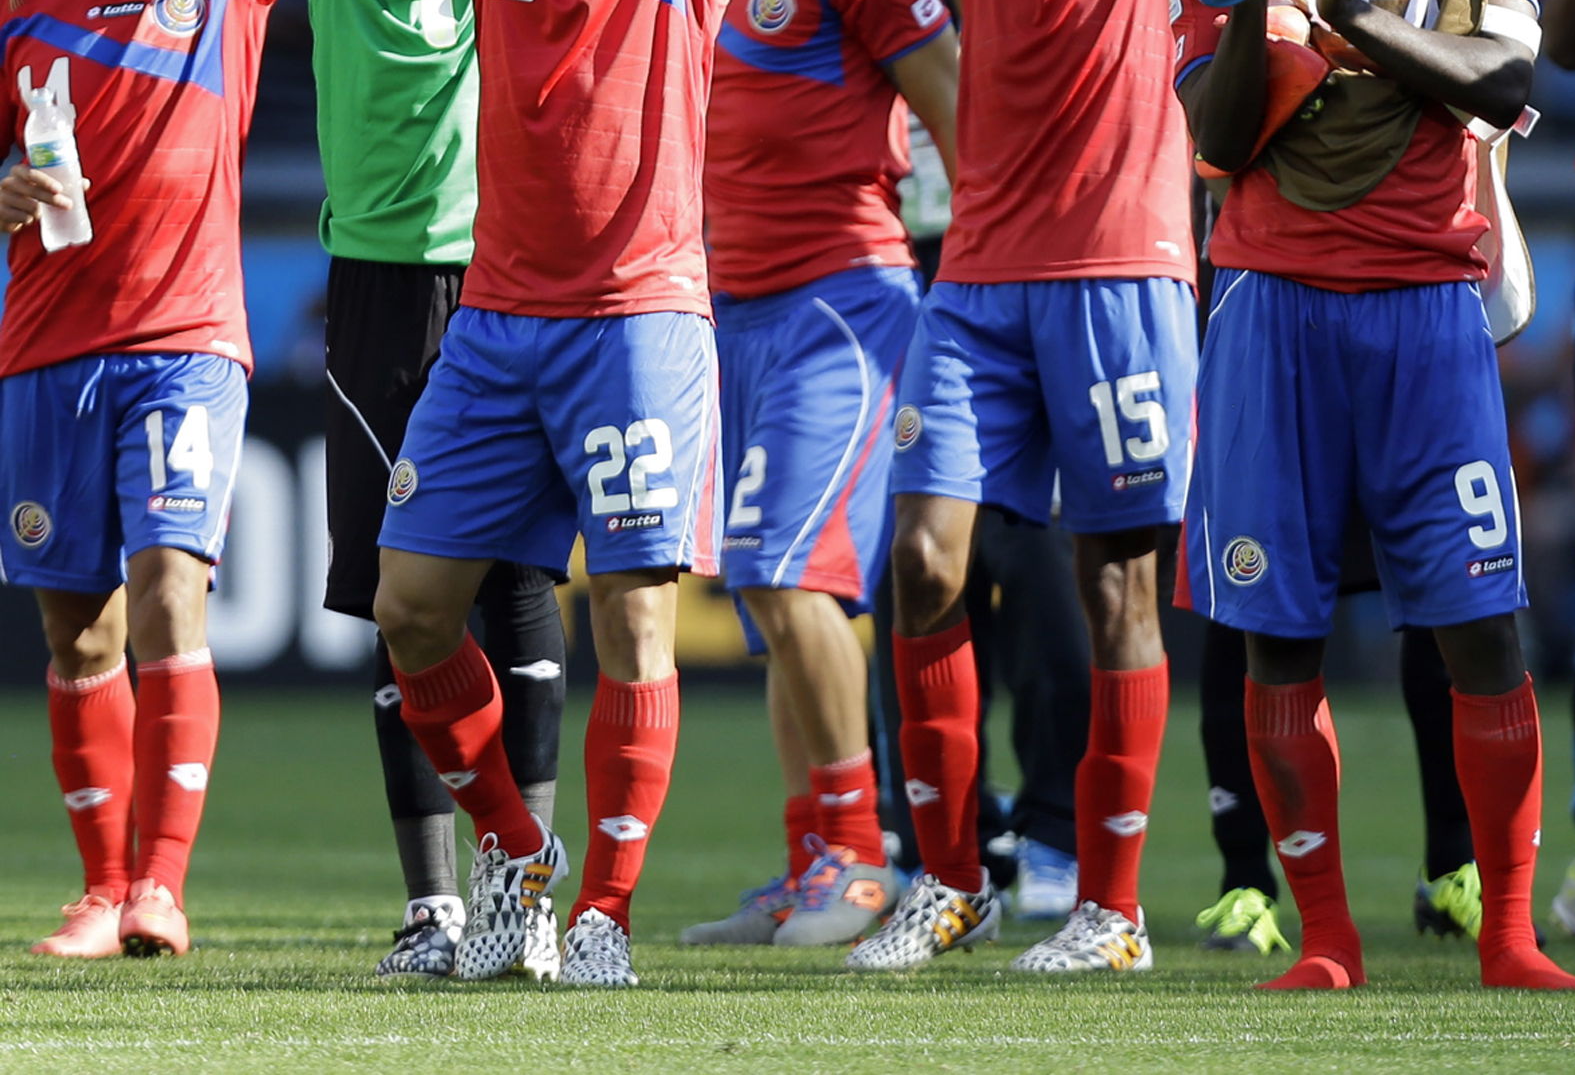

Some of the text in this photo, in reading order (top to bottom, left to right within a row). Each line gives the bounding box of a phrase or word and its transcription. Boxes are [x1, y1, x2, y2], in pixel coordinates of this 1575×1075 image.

[145, 405, 214, 491] 14
[1089, 370, 1170, 467] 15
[584, 417, 679, 515] 22
[1454, 459, 1508, 549] 9
